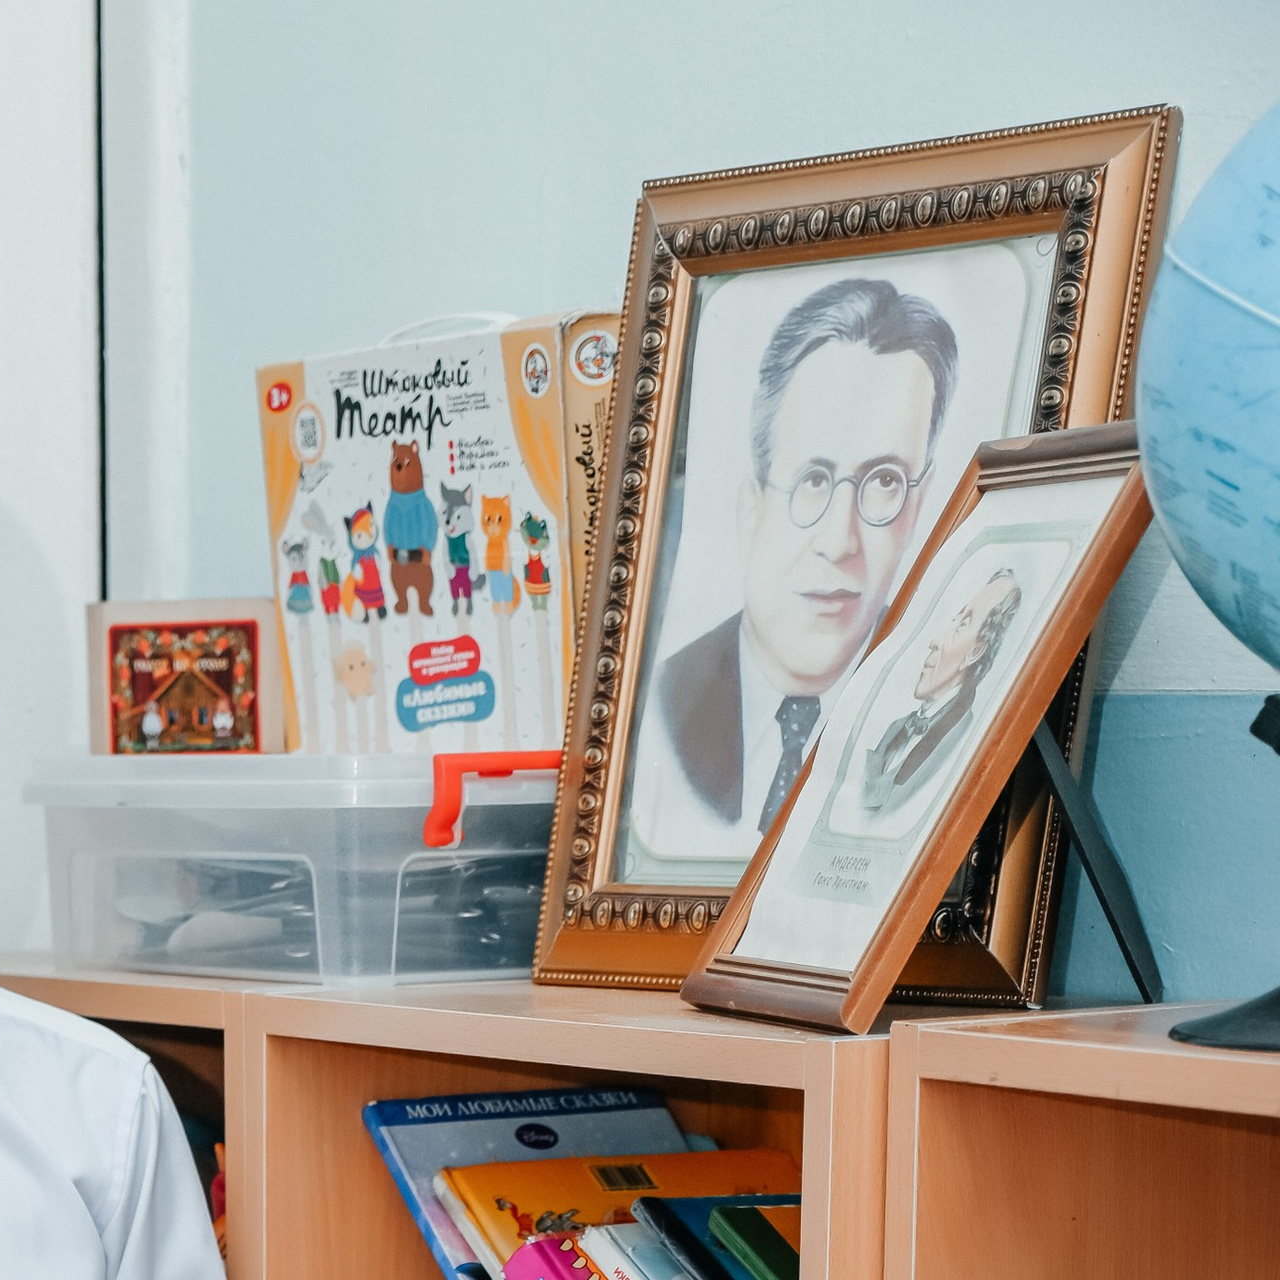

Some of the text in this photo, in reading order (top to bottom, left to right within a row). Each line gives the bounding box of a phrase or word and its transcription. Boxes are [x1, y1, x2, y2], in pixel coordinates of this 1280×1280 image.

[362, 358, 470, 398] Штоковый
[269, 386, 291, 410] 3+
[405, 1091, 638, 1120] МОИ ЛЮБИМЫЕ СКАЗКИ
